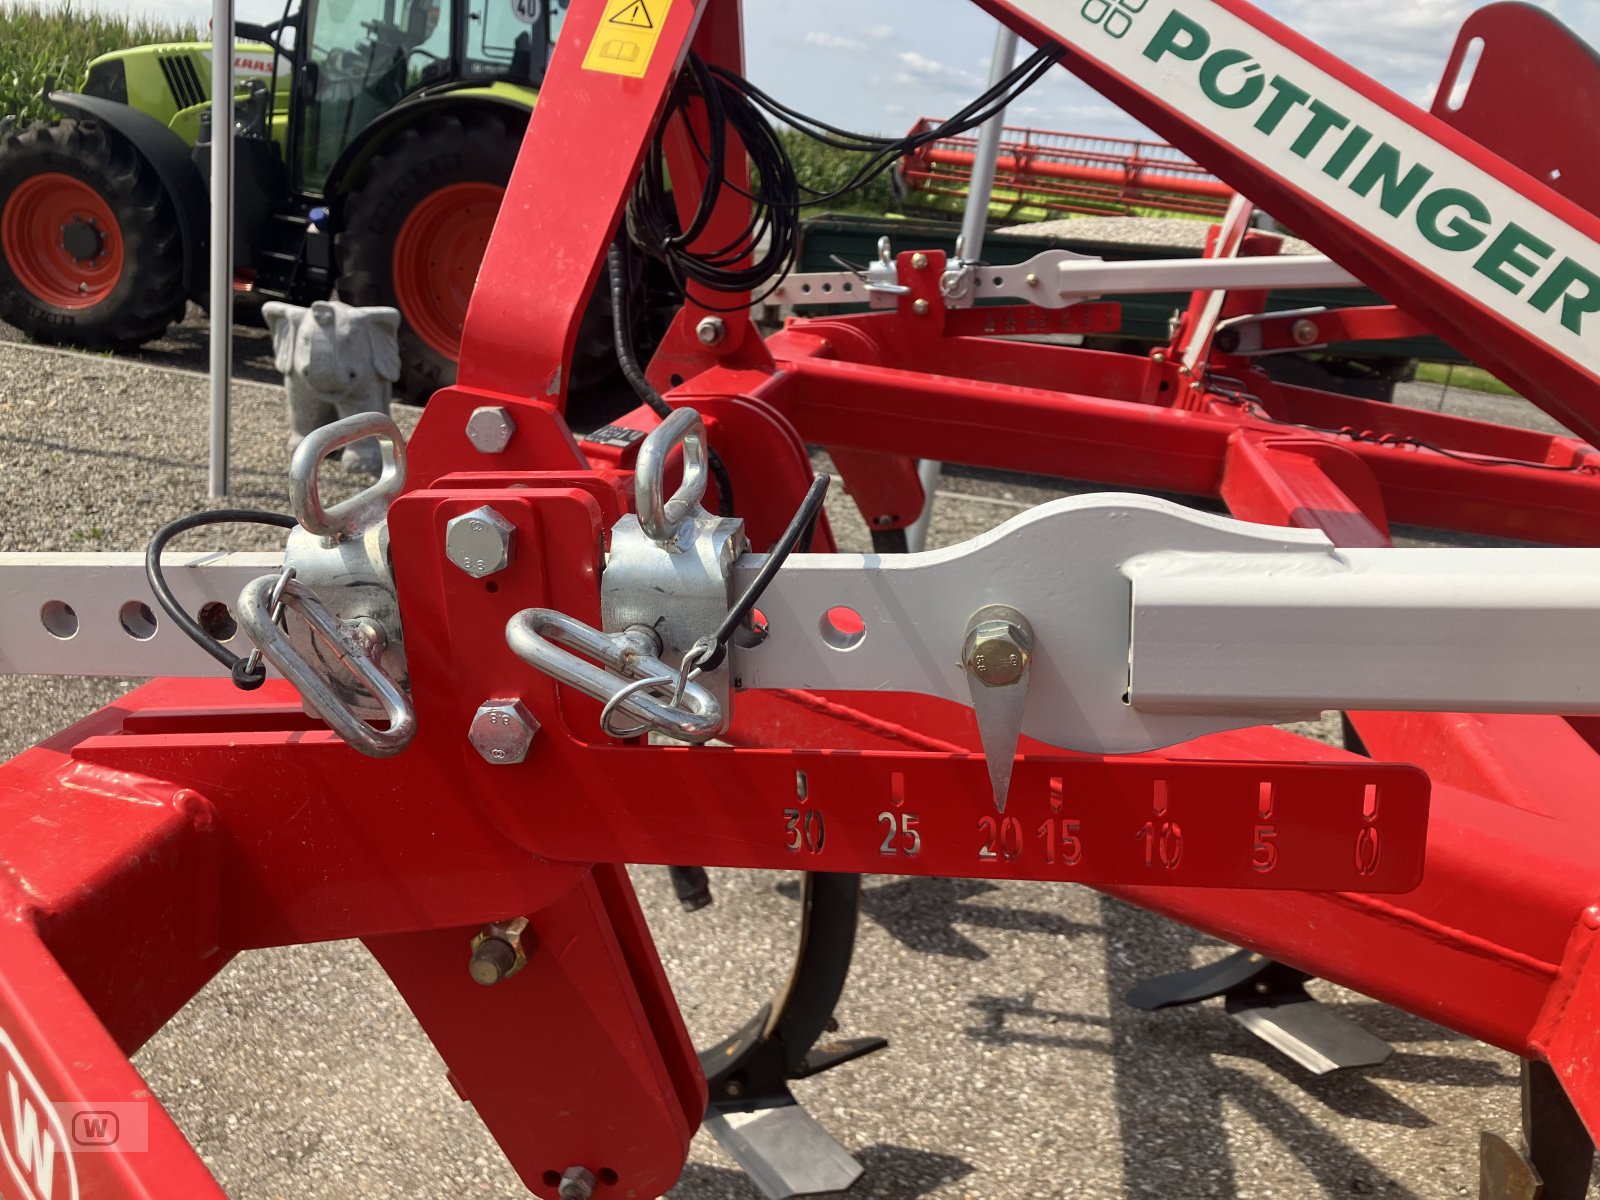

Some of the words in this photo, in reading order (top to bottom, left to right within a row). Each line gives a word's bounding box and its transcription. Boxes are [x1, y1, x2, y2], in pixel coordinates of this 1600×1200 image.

[233, 57, 274, 72] LAAS
[784, 808, 824, 854] 30
[878, 811, 921, 857] 25
[977, 815, 1023, 862] 20
[1037, 818, 1082, 866] 15
[1136, 821, 1183, 870] 10
[1252, 825, 1277, 873] 5
[1354, 826, 1381, 876] 0
